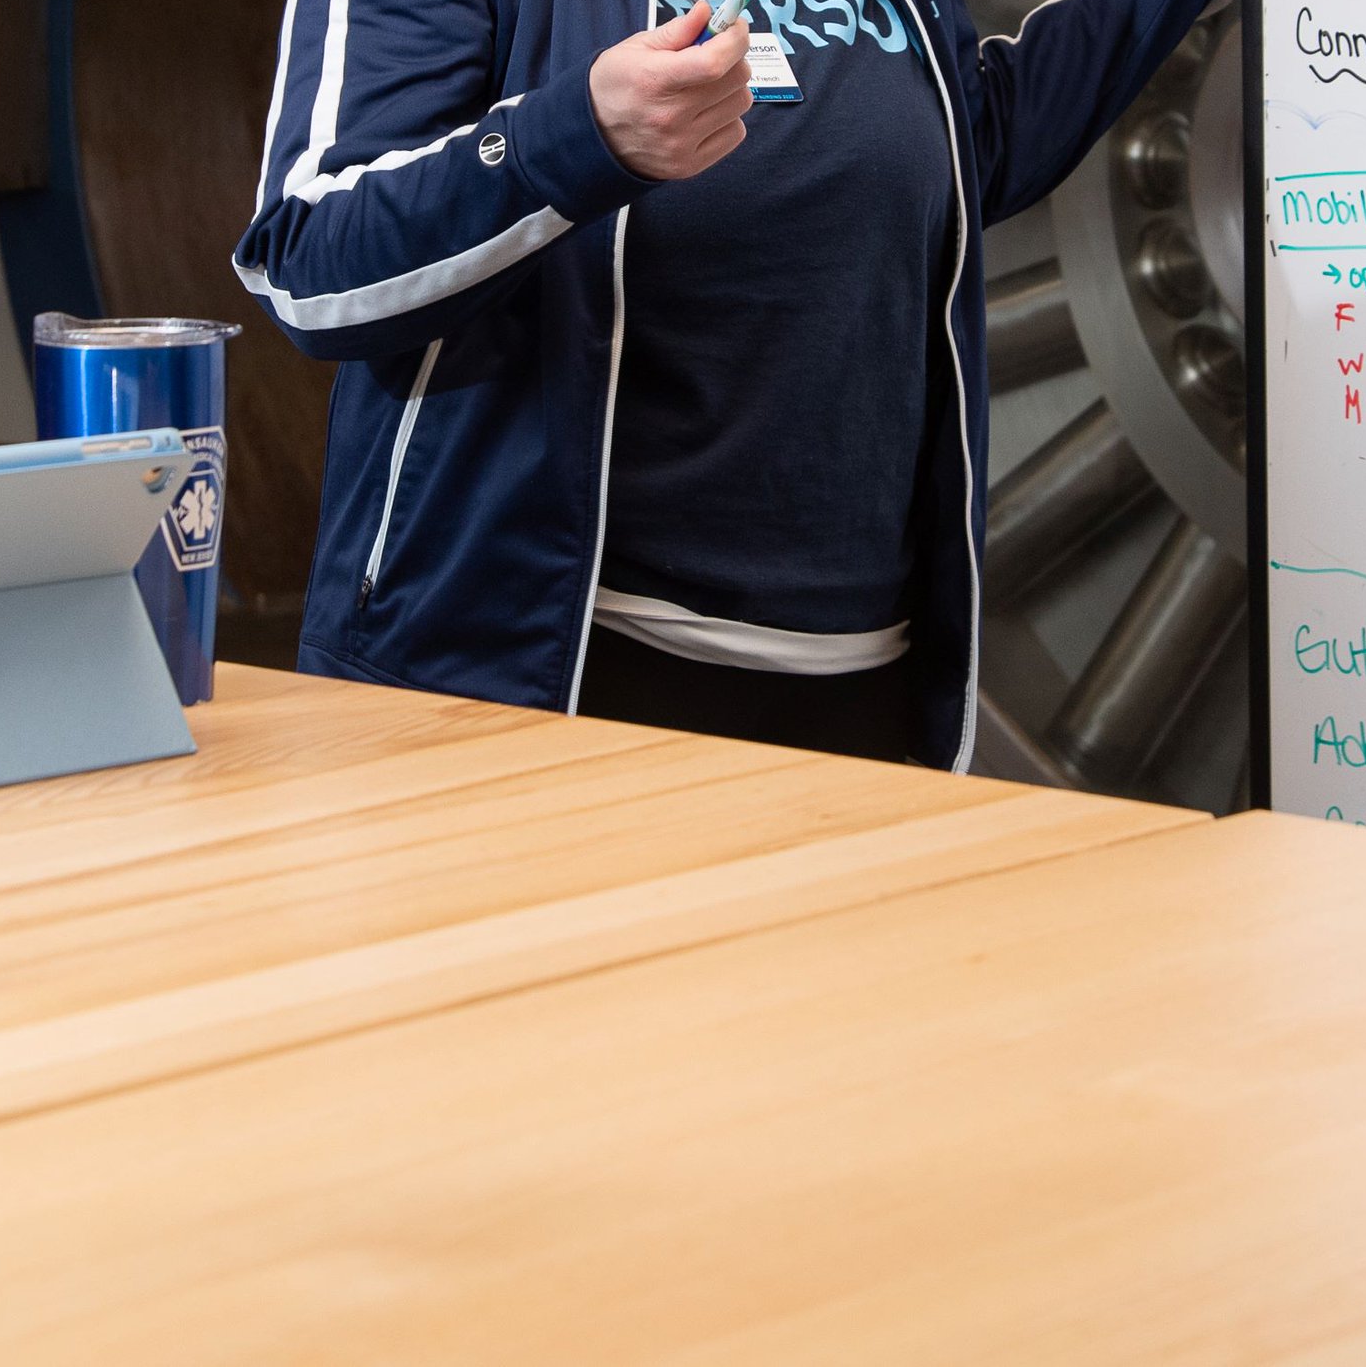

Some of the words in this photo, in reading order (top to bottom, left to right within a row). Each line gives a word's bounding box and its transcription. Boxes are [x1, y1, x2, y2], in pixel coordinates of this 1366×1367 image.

[748, 45, 778, 53] erson
[1334, 302, 1356, 332] F
[1345, 386, 1362, 426] M
